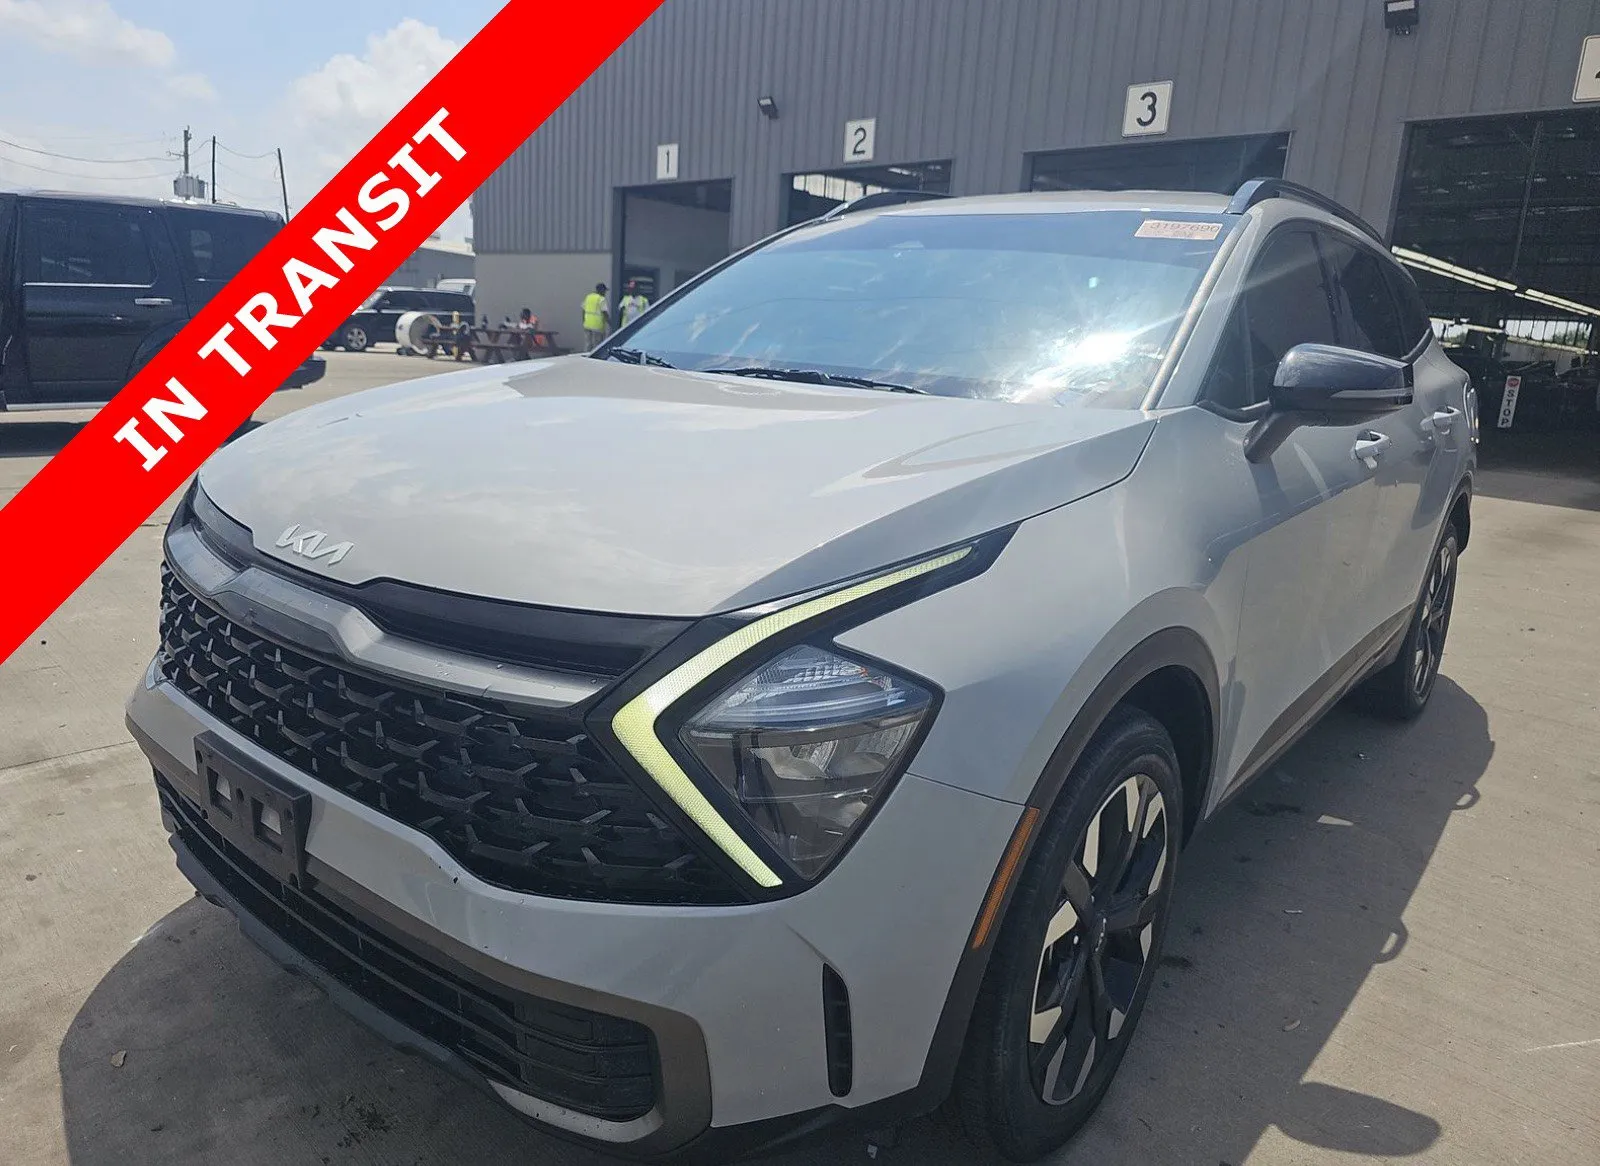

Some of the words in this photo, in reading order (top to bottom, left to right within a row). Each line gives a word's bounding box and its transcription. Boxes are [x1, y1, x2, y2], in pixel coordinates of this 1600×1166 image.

[1136, 91, 1157, 127] 3
[852, 128, 867, 155] 2
[1500, 389, 1515, 426] STOP
[276, 524, 354, 566] KIA
